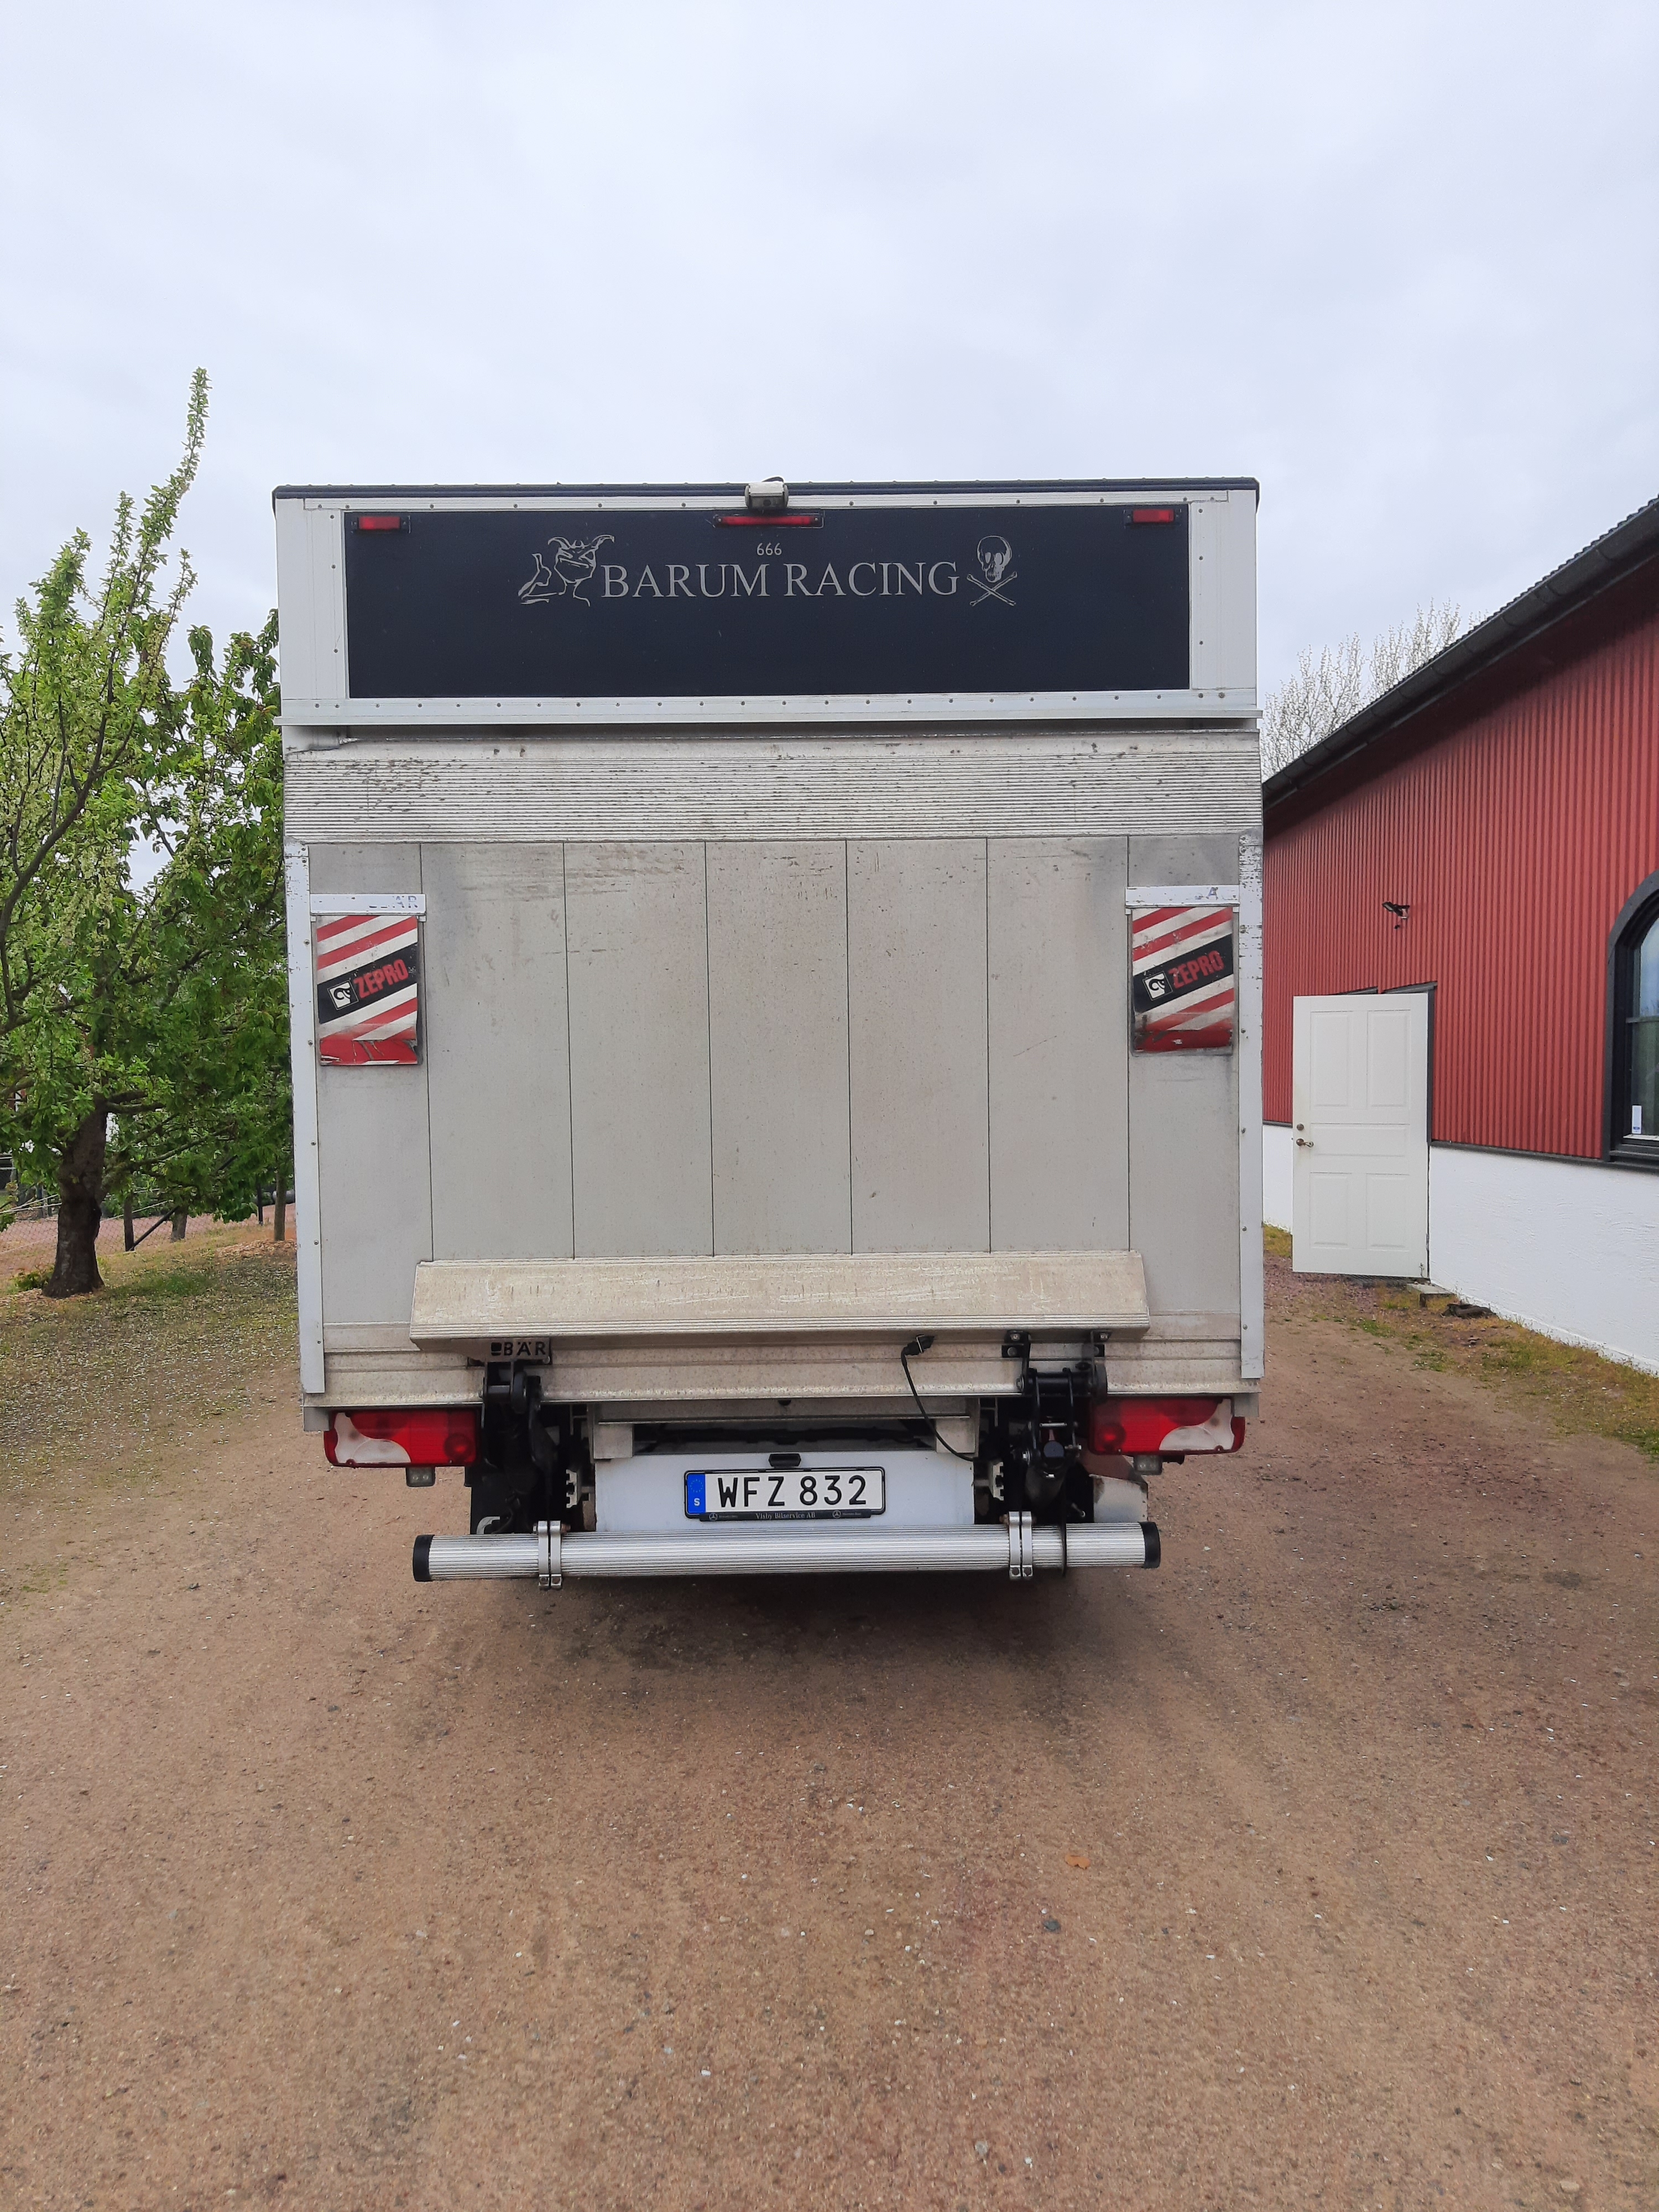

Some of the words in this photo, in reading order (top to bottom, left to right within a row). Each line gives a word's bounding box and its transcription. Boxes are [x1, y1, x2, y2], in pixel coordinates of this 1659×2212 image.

[757, 542, 782, 556] 666
[601, 564, 770, 598] BARUM
[783, 561, 959, 597] RACING
[353, 958, 409, 999] ZEPRO
[1167, 950, 1225, 989] ZEPRO
[503, 1340, 546, 1356] BÄR
[693, 1498, 701, 1506] S
[717, 1476, 785, 1507] WFZ
[799, 1475, 867, 1506] 832
